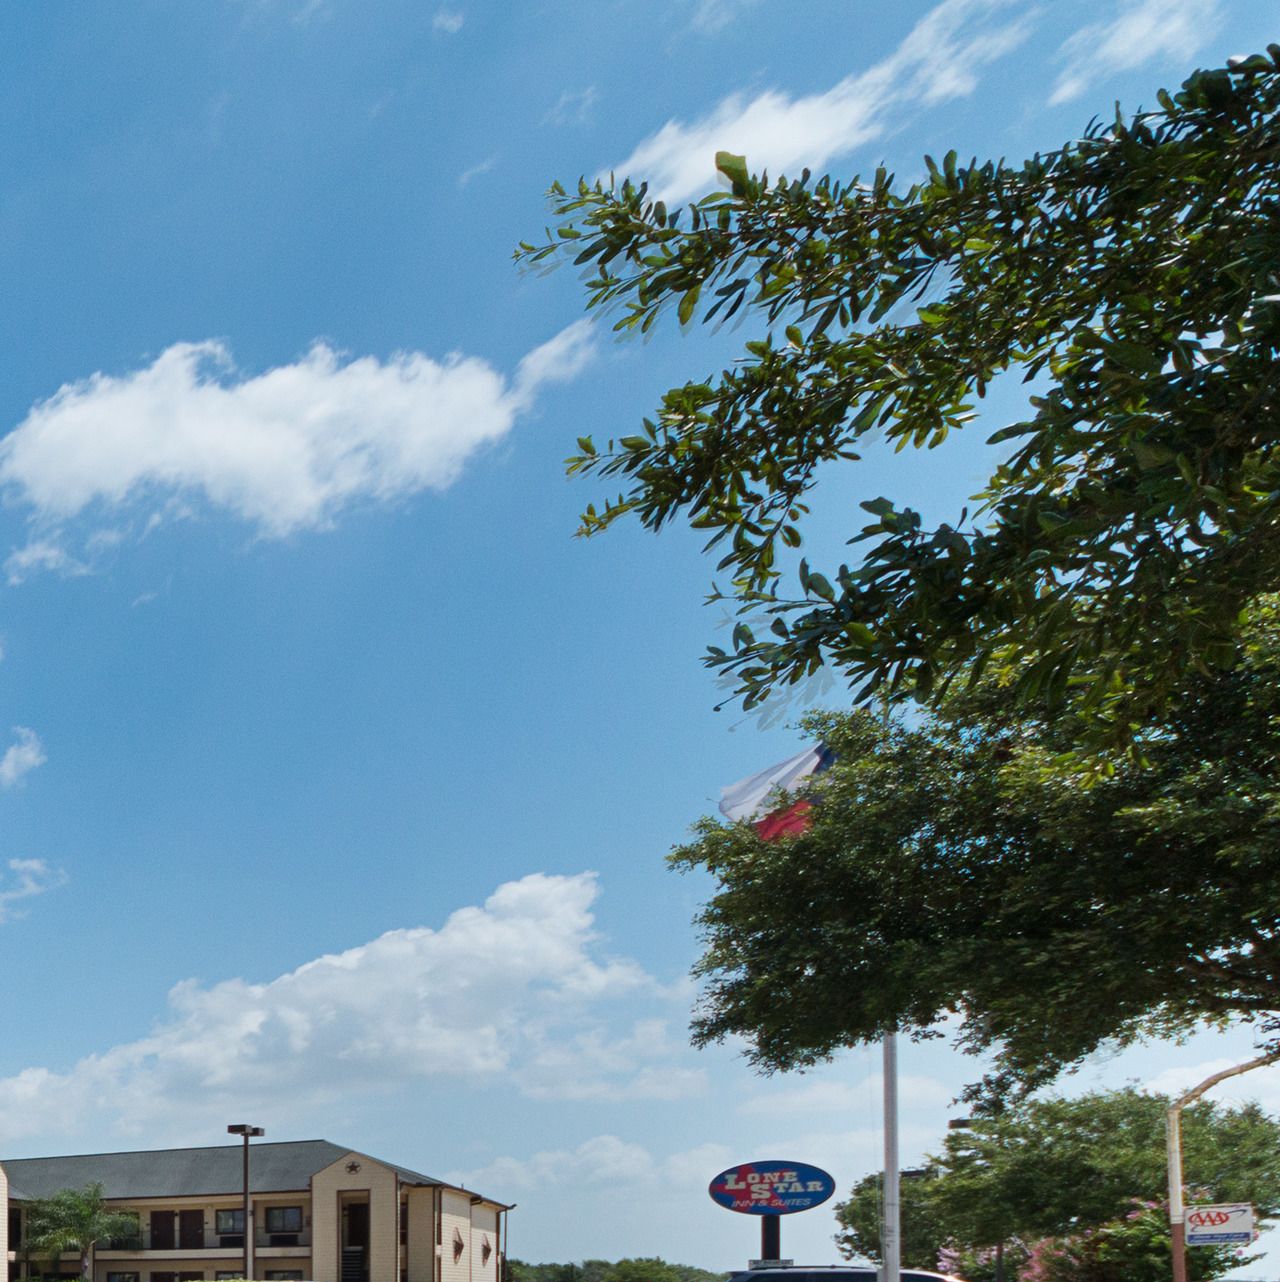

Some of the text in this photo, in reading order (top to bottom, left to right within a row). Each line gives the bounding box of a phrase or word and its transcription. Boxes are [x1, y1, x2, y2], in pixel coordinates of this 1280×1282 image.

[725, 1172, 798, 1190] LONE
[751, 1181, 824, 1200] STAR
[771, 1198, 811, 1206] SUITES
[1189, 1211, 1230, 1226] AAA
